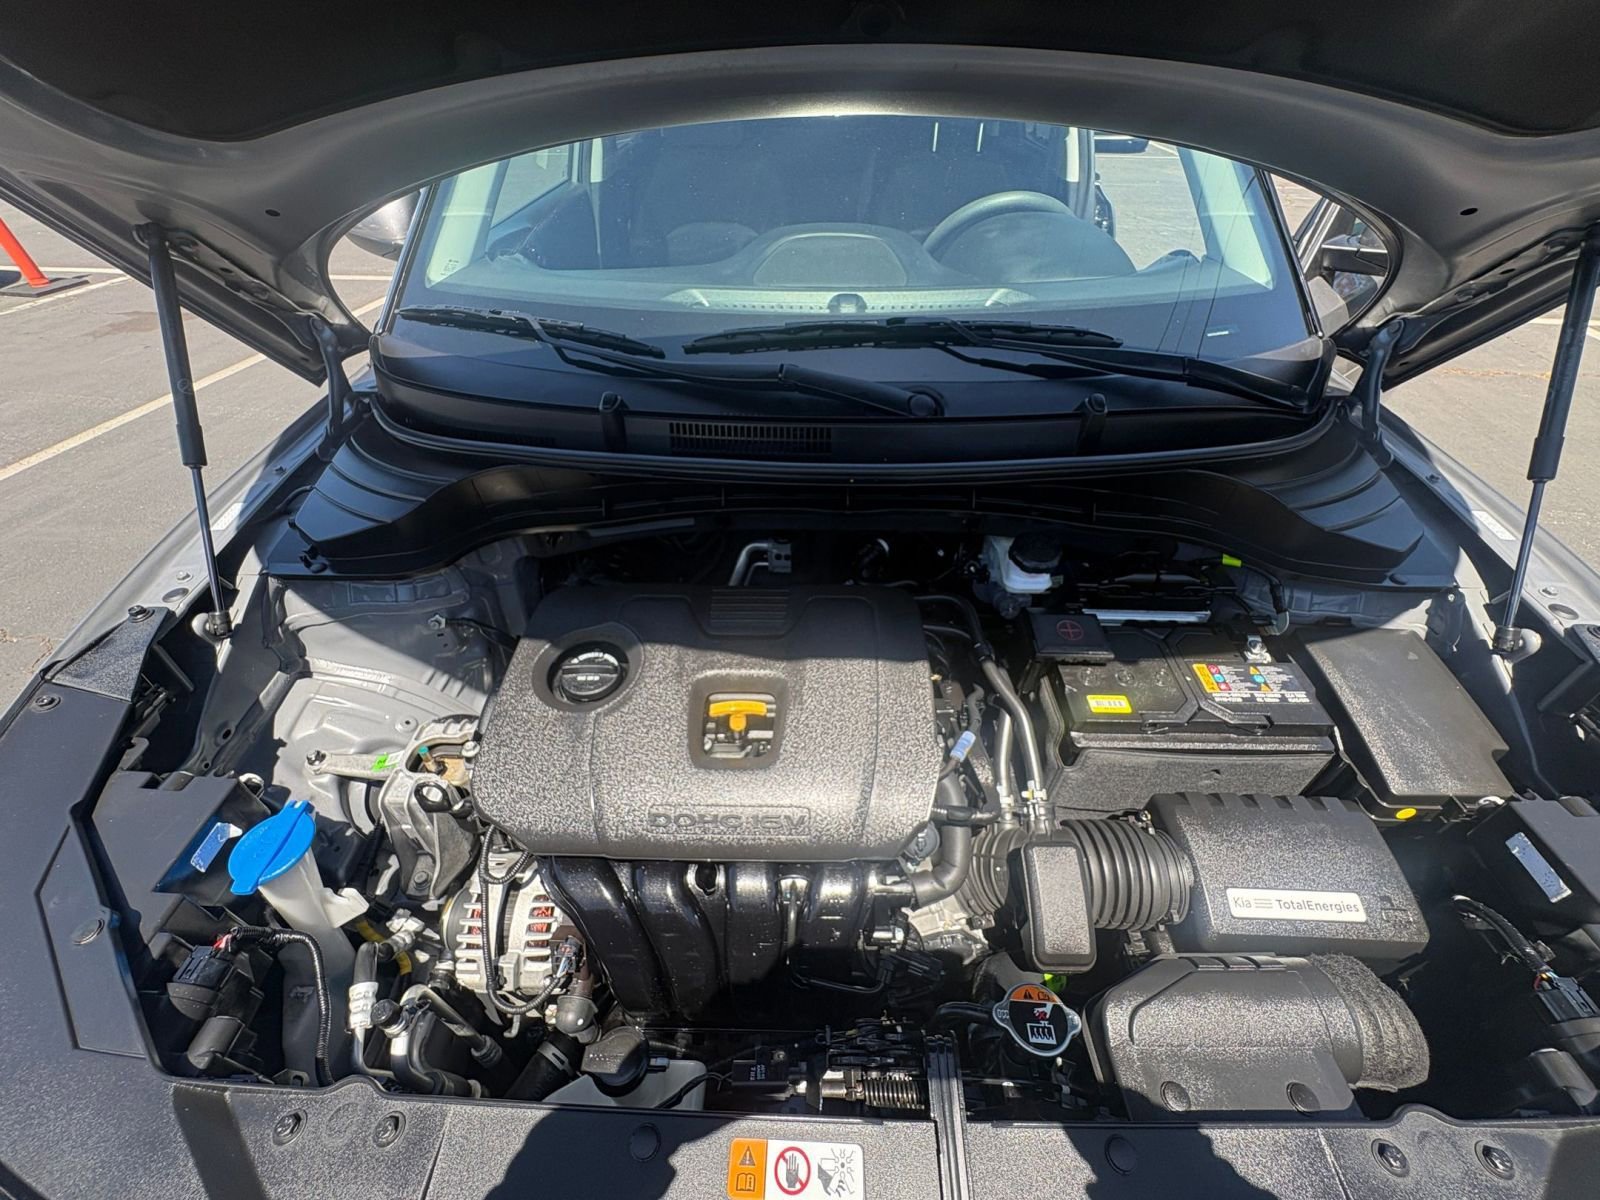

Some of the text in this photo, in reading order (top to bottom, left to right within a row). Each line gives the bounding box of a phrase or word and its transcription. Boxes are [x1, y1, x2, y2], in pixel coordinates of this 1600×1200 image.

[648, 813, 743, 829] DOHC
[1233, 896, 1360, 914] Kia TotalEnergies
